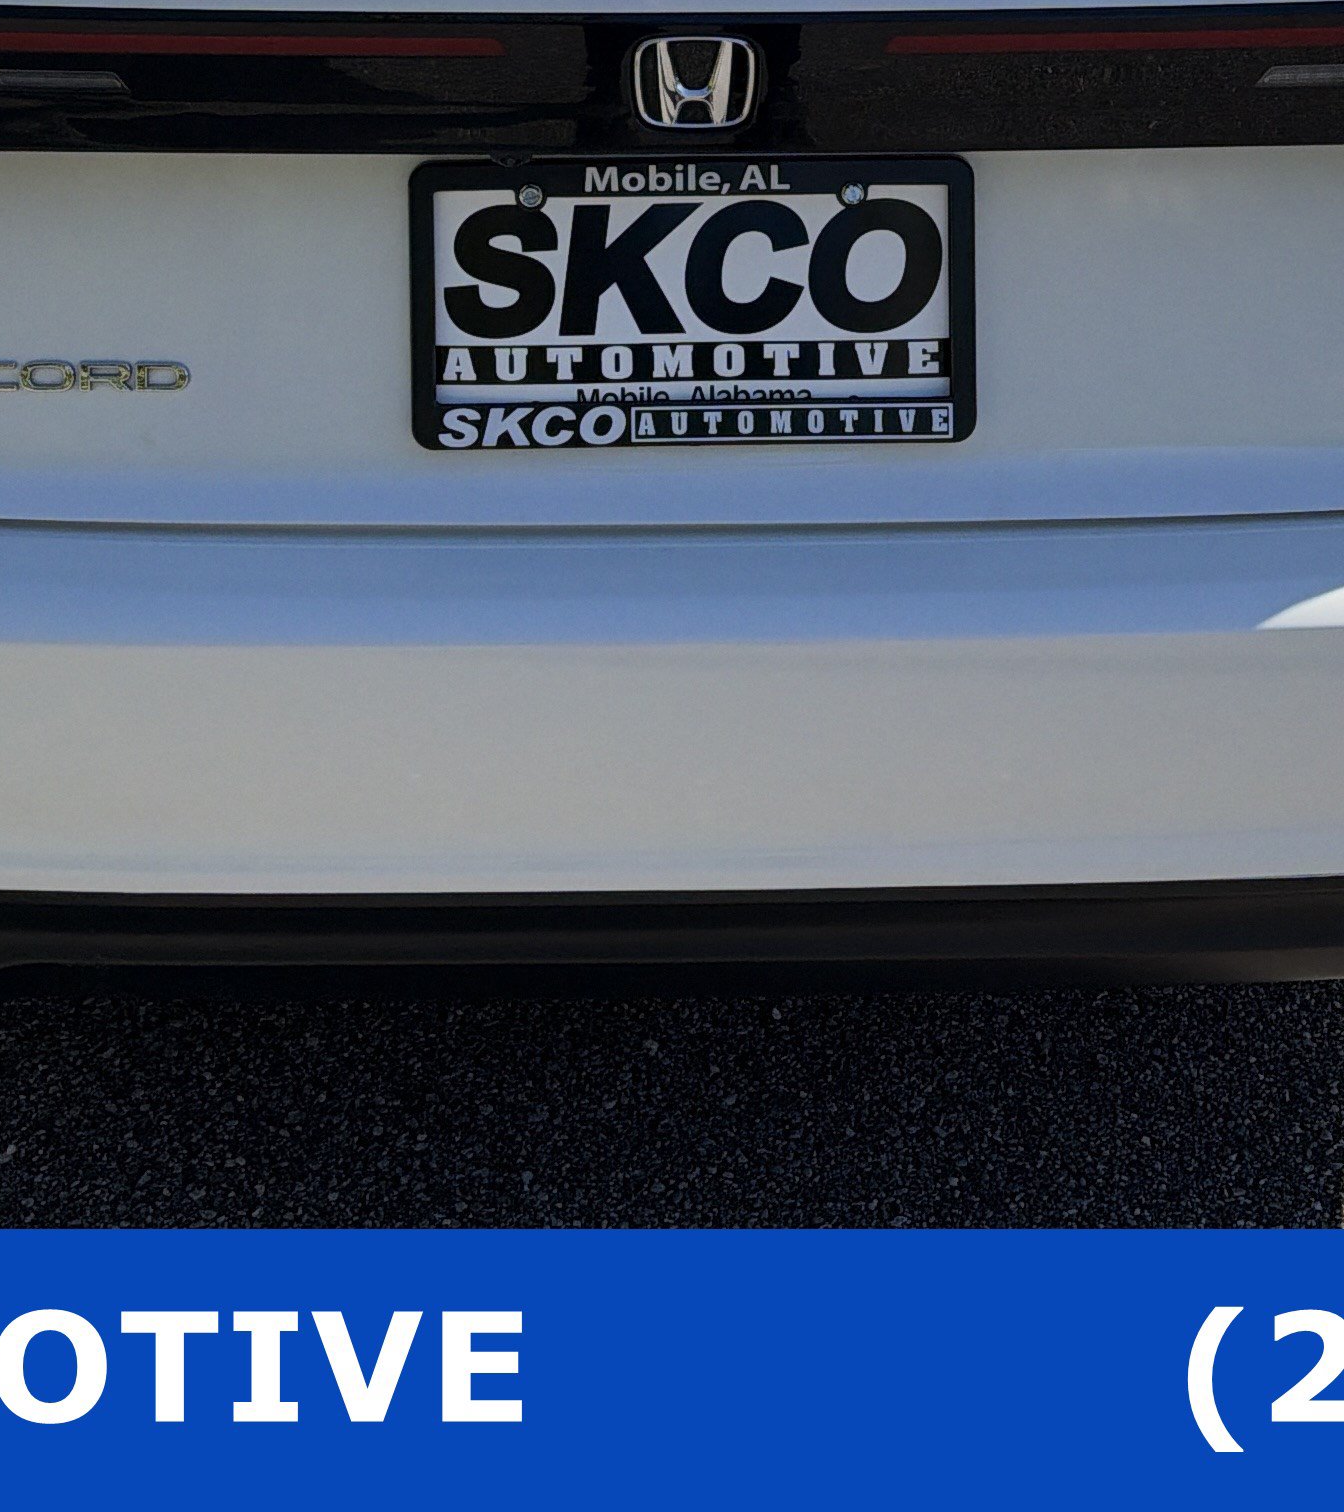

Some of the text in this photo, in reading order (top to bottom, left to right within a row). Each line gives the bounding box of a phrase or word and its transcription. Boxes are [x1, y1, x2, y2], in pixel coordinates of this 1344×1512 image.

[584, 163, 791, 195] Mobile, AL
[443, 198, 944, 339] SKCO
[442, 340, 941, 382] AUTOMOTIVE
[437, 406, 949, 447] SKCO AUTOMOTIVE
